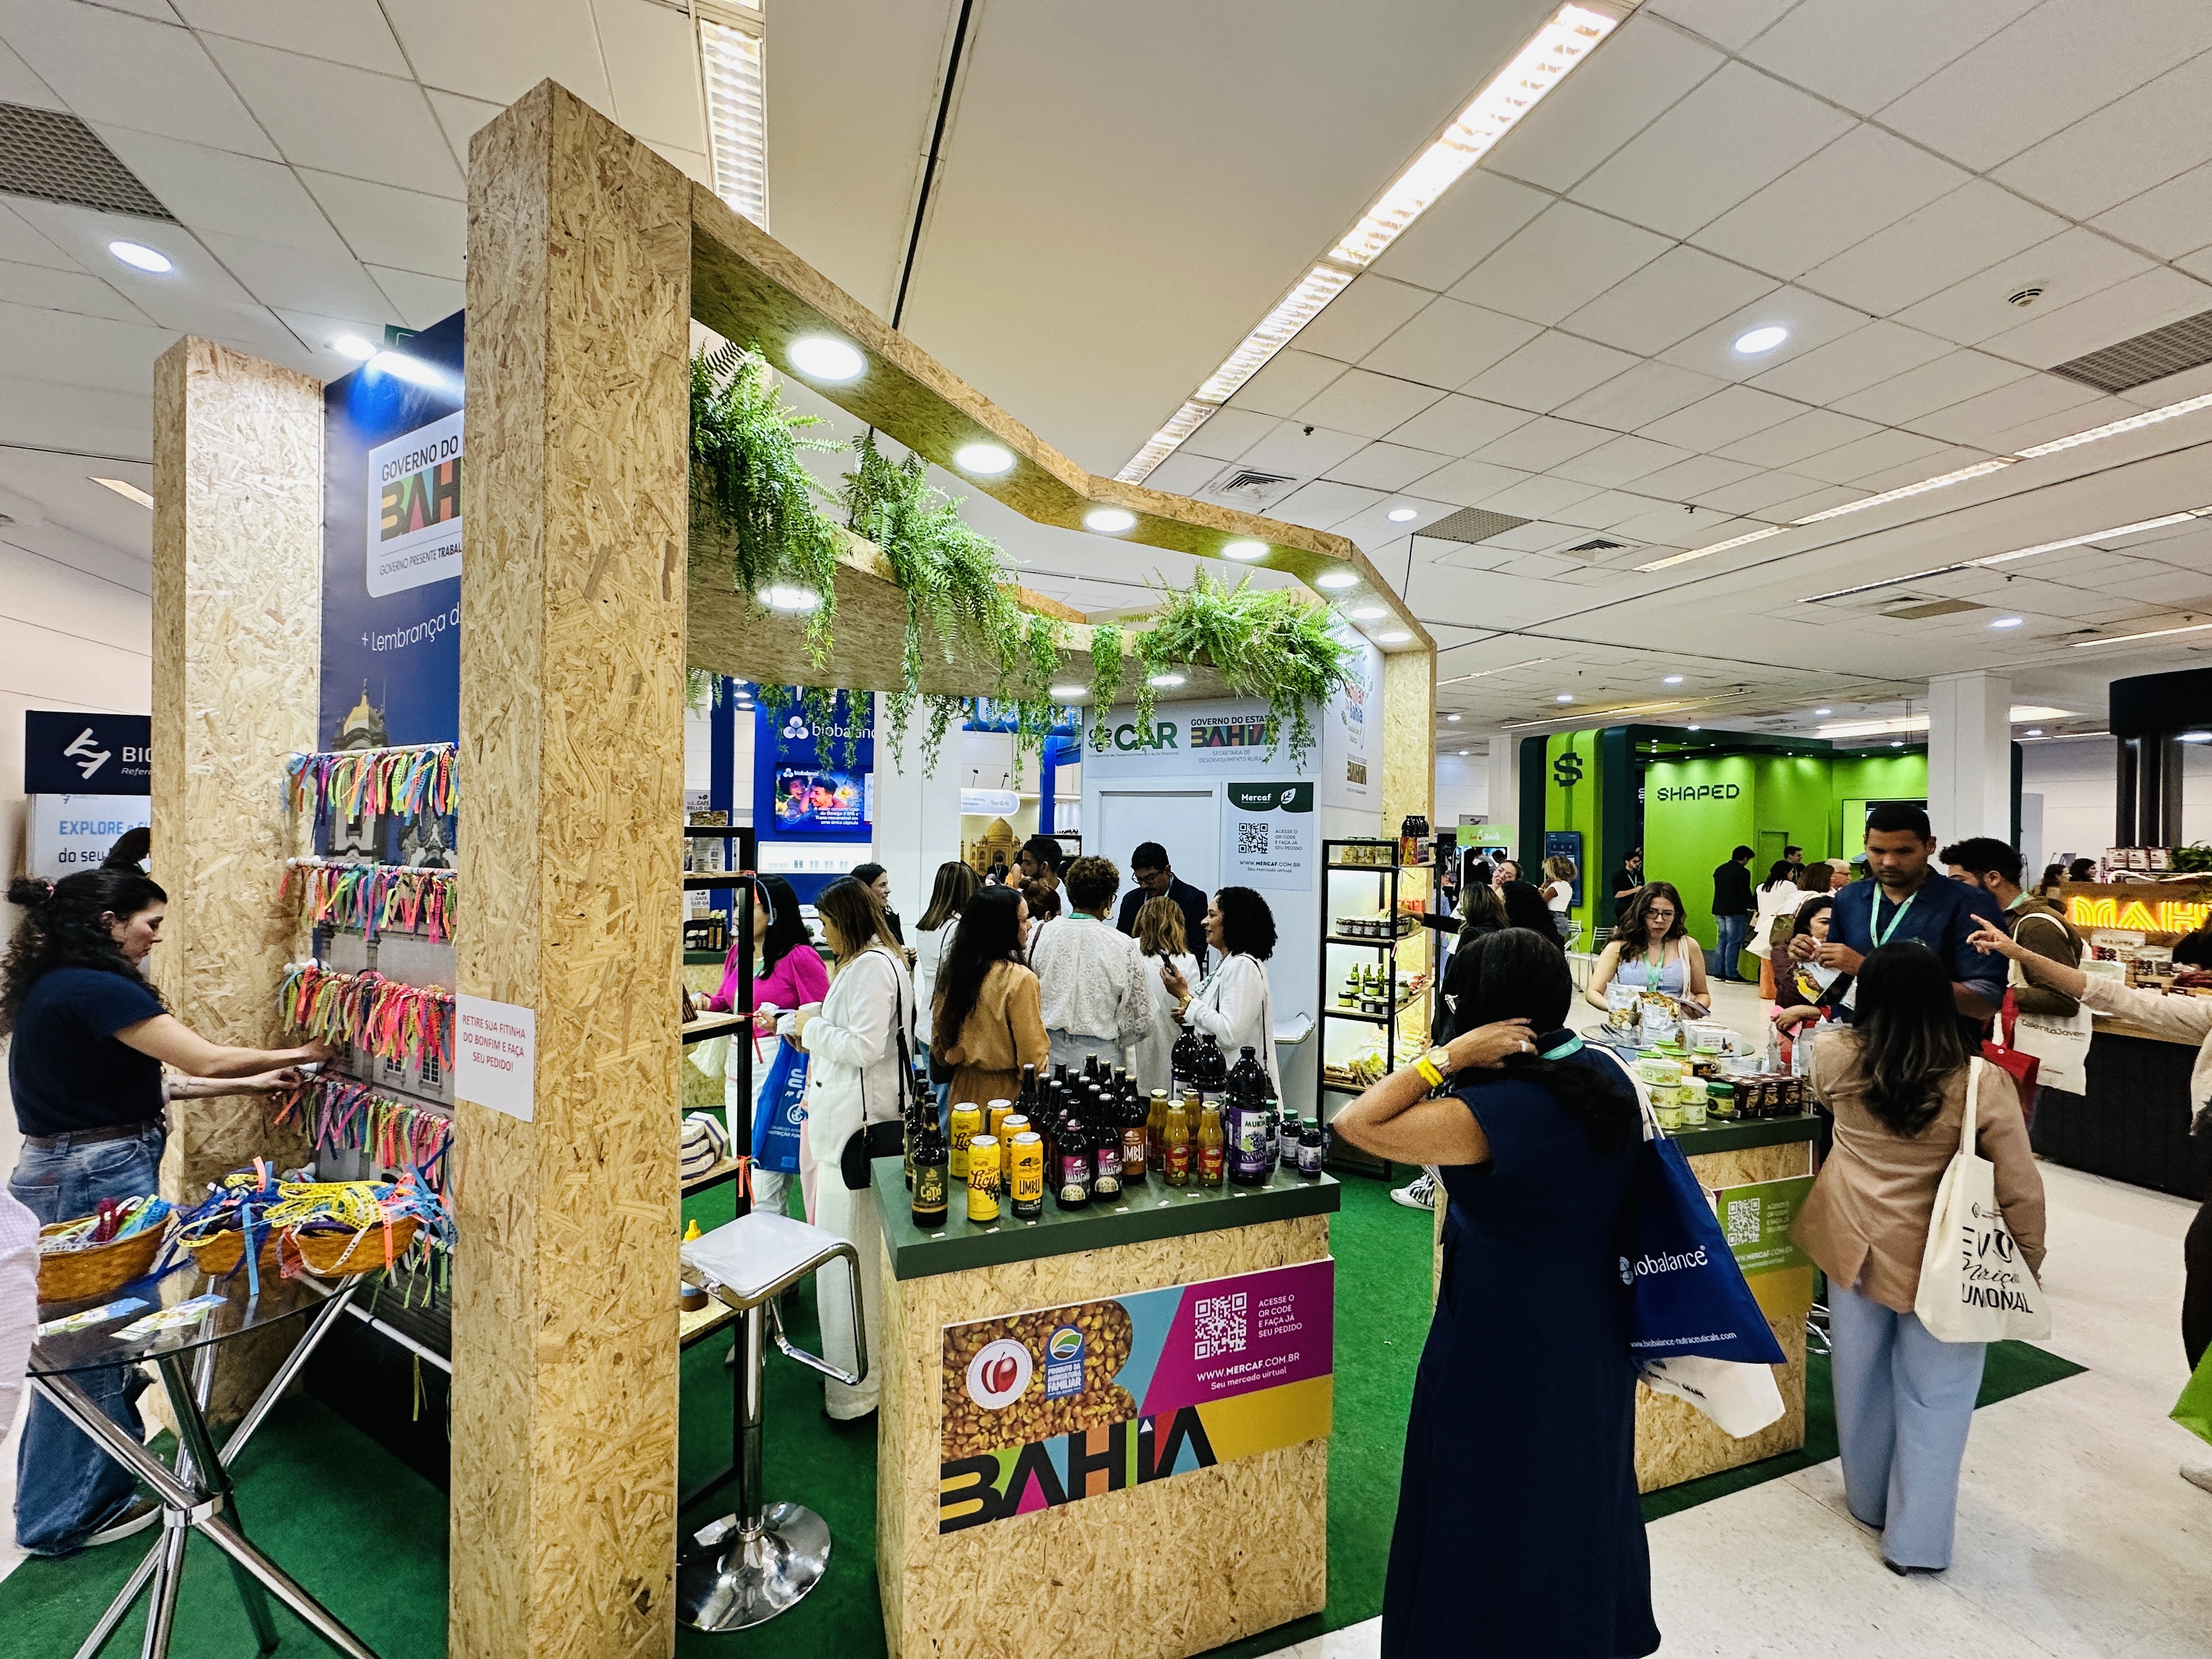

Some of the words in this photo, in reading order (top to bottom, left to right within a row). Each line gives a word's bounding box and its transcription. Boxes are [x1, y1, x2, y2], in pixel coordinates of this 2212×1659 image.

[382, 444, 437, 481] GOVERNO
[441, 435, 459, 458] DO
[380, 557, 409, 575] GOVERNO
[409, 549, 437, 571] PRESENTE
[372, 613, 445, 651] Lembrança
[450, 601, 460, 625] d
[1191, 718, 1229, 726] GOVERNO
[1114, 722, 1178, 751] CAR
[1657, 784, 1740, 801] SHAPED
[59, 820, 123, 835] EXPLORE
[59, 848, 76, 862] do
[81, 851, 104, 861] seu
[2073, 896, 2209, 933] MAH
[462, 1015, 484, 1029] RETIRE
[485, 1020, 498, 1031] SUA
[500, 1023, 526, 1039] FITINHA
[463, 1032, 473, 1043] DO
[475, 1035, 500, 1050] BONFIM
[503, 1042, 506, 1052] E
[508, 1043, 524, 1058] FAÇA
[473, 1052, 485, 1064] SEU
[487, 1055, 514, 1072] PEDIDO!
[1019, 1178, 1040, 1195] UMBU
[1259, 1296, 1286, 1307] ACESSE
[1259, 1309, 1269, 1317] QR
[1271, 1305, 1291, 1315] CODE
[1265, 1317, 1284, 1327] FAÇA
[1284, 1313, 1295, 1322] JÁ
[1259, 1329, 1272, 1338] SEU
[1274, 1323, 1302, 1335] PEDIDO
[1048, 1364, 1072, 1375] PRODUTO
[1197, 1352, 1300, 1381] WWW.MERCAF.COM.BR
[1048, 1370, 1081, 1381] AGRICULTURA
[1048, 1376, 1081, 1392] FAMILIAR
[1211, 1382, 1225, 1390] Seu
[1227, 1373, 1261, 1386] mercado
[1262, 1367, 1286, 1378] virtual
[939, 1406, 1218, 1534] BAHIA
